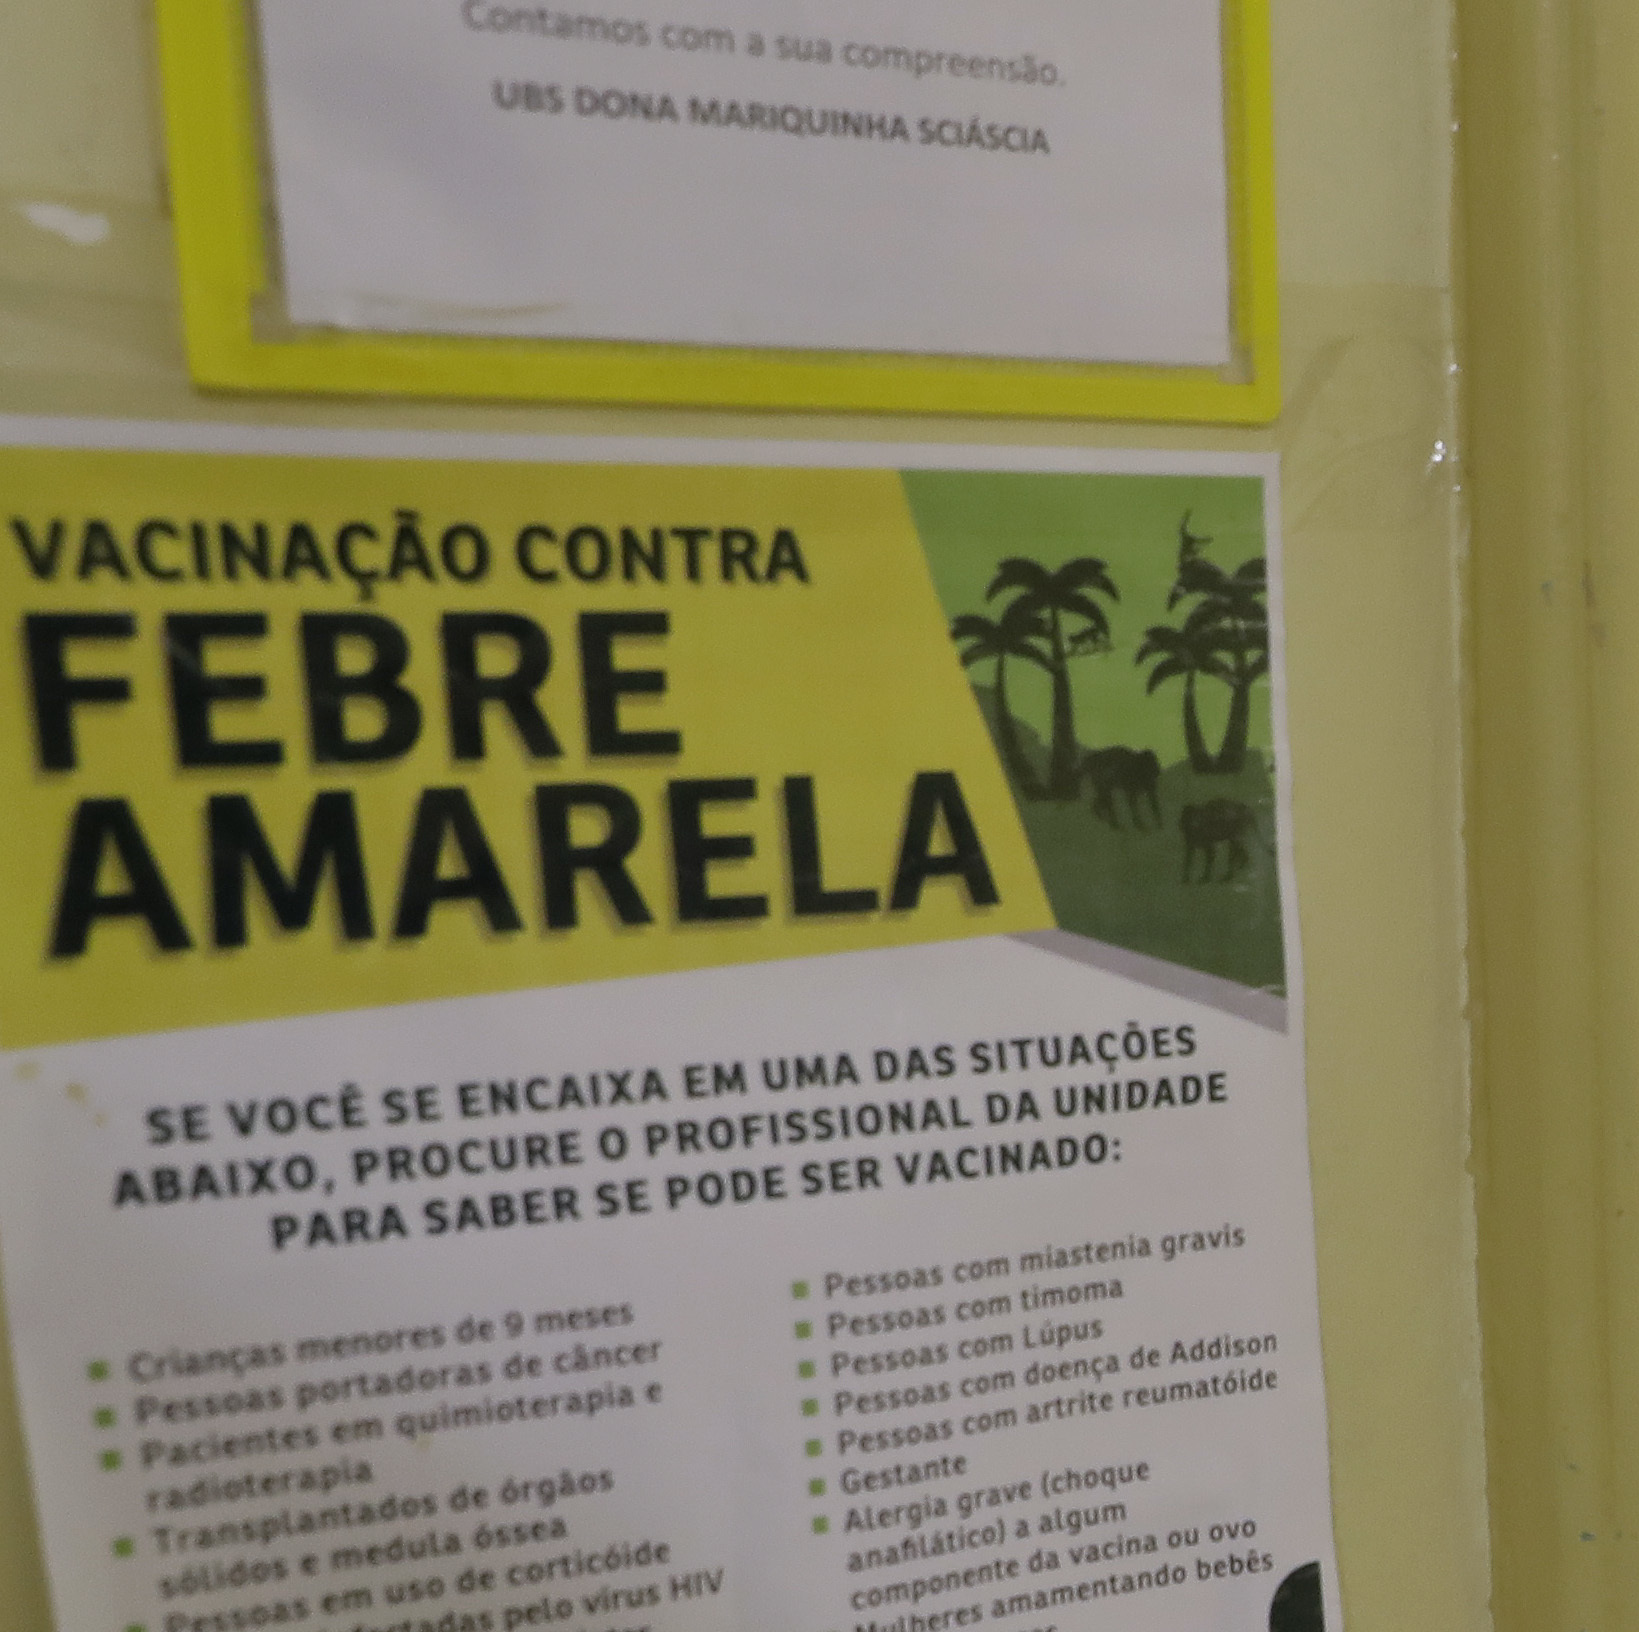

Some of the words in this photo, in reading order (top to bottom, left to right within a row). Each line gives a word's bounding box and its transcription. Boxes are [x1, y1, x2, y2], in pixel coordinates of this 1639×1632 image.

[658, 23, 735, 53] com
[746, 32, 765, 57] a
[774, 35, 833, 65] sua
[493, 81, 565, 114] UBS
[573, 87, 679, 122] DONA
[688, 97, 910, 143] MARIQUINHA
[9, 509, 491, 603] VACINAÇÃO
[514, 523, 810, 586] CONTRA
[20, 610, 683, 775] FEBRE
[46, 770, 1001, 962] AMARELA
[146, 1104, 210, 1146] SE
[226, 1083, 366, 1138] VOCÊ
[382, 1085, 441, 1125] SE
[457, 1068, 669, 1119] ENCAIXA
[682, 1061, 747, 1100] EM
[761, 1053, 860, 1092] UMA
[873, 1044, 956, 1083] DAS
[969, 1021, 1197, 1075] SITUAÇÕES
[114, 1155, 334, 1207] ABAIXO,
[352, 1130, 582, 1184] PROCURE
[598, 1126, 628, 1161] O
[644, 1096, 972, 1157] PROFISSIONAL
[985, 1090, 1041, 1125] DA
[1053, 1072, 1227, 1118] UNIDADE
[271, 1204, 408, 1250] PARA
[423, 1187, 579, 1235] SABER
[595, 1180, 650, 1217] SE
[666, 1166, 786, 1209] PODE
[801, 1157, 881, 1196] SER
[895, 1132, 1120, 1185] VACINADO:
[825, 1265, 943, 1298] Pessoas
[953, 1257, 1010, 1283] com
[1020, 1233, 1152, 1273] miastenia
[1160, 1224, 1245, 1262] gravis
[128, 1343, 286, 1384] Crianças
[295, 1324, 446, 1361] menores
[453, 1316, 495, 1345] de
[502, 1311, 524, 1339] 9
[533, 1303, 634, 1334] meses
[827, 1304, 946, 1338] Pessoas
[954, 1294, 1012, 1322] com
[1020, 1278, 1123, 1312] timoma
[133, 1386, 286, 1426] Pessoas
[294, 1362, 492, 1411] portadoras
[502, 1351, 543, 1381] de
[552, 1342, 661, 1374] câncer
[831, 1343, 948, 1377] Pessoas
[957, 1333, 1013, 1360] com
[1023, 1319, 1103, 1351] Lúpus
[834, 1382, 951, 1416] Pessoas
[960, 1371, 1015, 1397] com
[1024, 1355, 1120, 1386] doença
[1129, 1345, 1160, 1370] de
[1169, 1333, 1277, 1364] Addison
[139, 1426, 319, 1468] Pacientes
[330, 1417, 384, 1445] em
[394, 1384, 635, 1440] quimioterapia
[645, 1382, 662, 1403] e
[838, 1420, 953, 1455] Pessoas
[962, 1408, 1017, 1435] com
[1026, 1390, 1113, 1424] artrite
[1123, 1367, 1277, 1408] reumatóide
[147, 1459, 375, 1512] radioterapia
[840, 1455, 966, 1495] Gestante
[844, 1495, 948, 1533] Alergia
[957, 1481, 1032, 1520] grave
[153, 1494, 438, 1554] Transplantados
[448, 1485, 488, 1513] de
[299, 1553, 319, 1576] e
[330, 1531, 463, 1569] medula
[1015, 1519, 1030, 1539] a
[1039, 1503, 1126, 1536] algum
[318, 1588, 373, 1616] em
[383, 1576, 445, 1606] uso
[455, 1567, 495, 1595] de
[668, 1569, 723, 1601] HIV
[851, 1559, 1019, 1611] componente
[1027, 1548, 1060, 1574] da
[1068, 1534, 1158, 1565] vacina
[1167, 1527, 1199, 1549] ou
[1208, 1520, 1256, 1544] ovo
[992, 1562, 1187, 1618] amamentando
[1195, 1548, 1273, 1582] bebês
